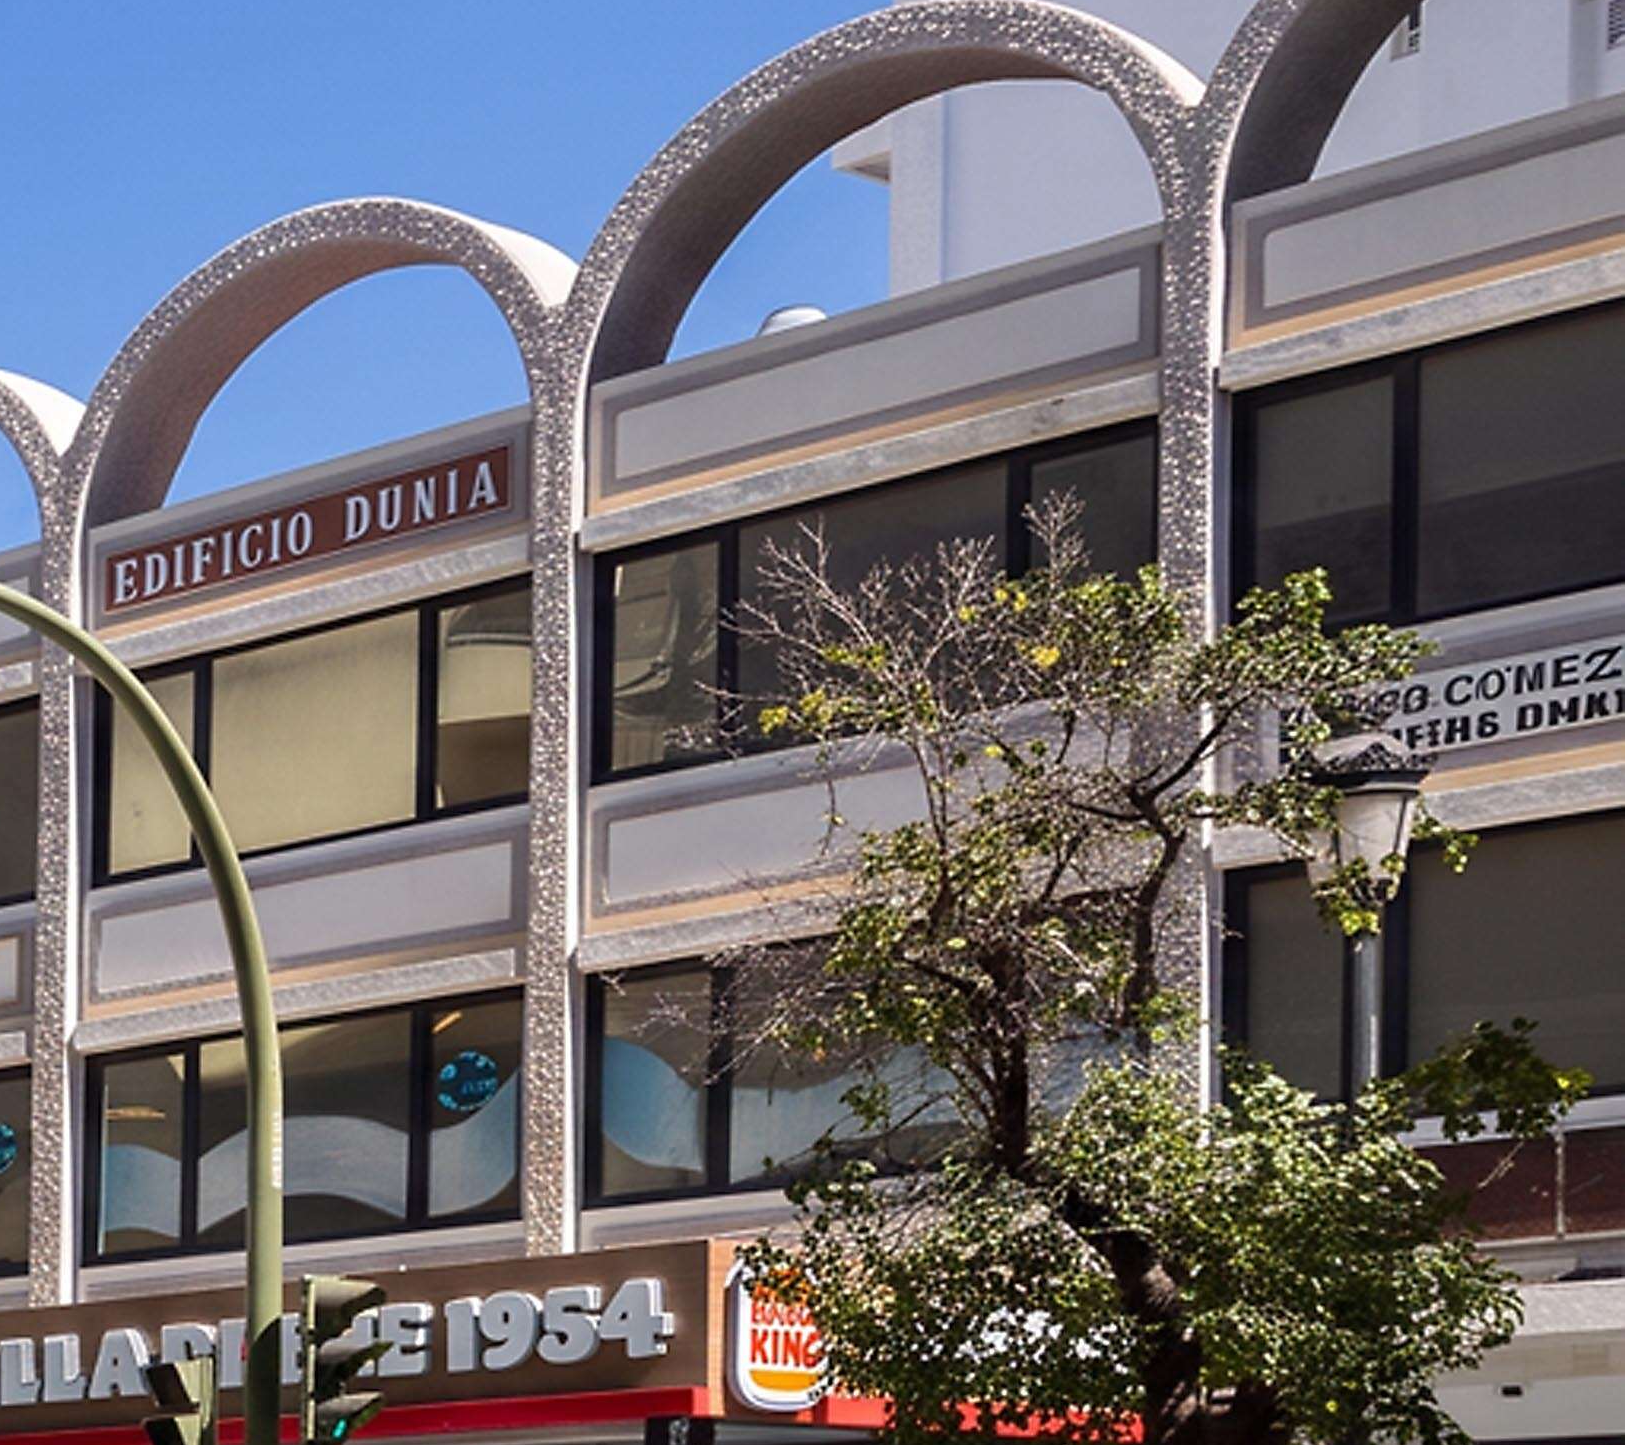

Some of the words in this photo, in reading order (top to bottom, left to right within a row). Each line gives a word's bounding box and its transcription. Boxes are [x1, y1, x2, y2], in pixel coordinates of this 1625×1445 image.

[114, 511, 314, 604] EDIFICIO
[344, 461, 498, 541] DUNIA
[445, 1277, 674, 1373] 1954
[750, 1327, 824, 1368] KING
